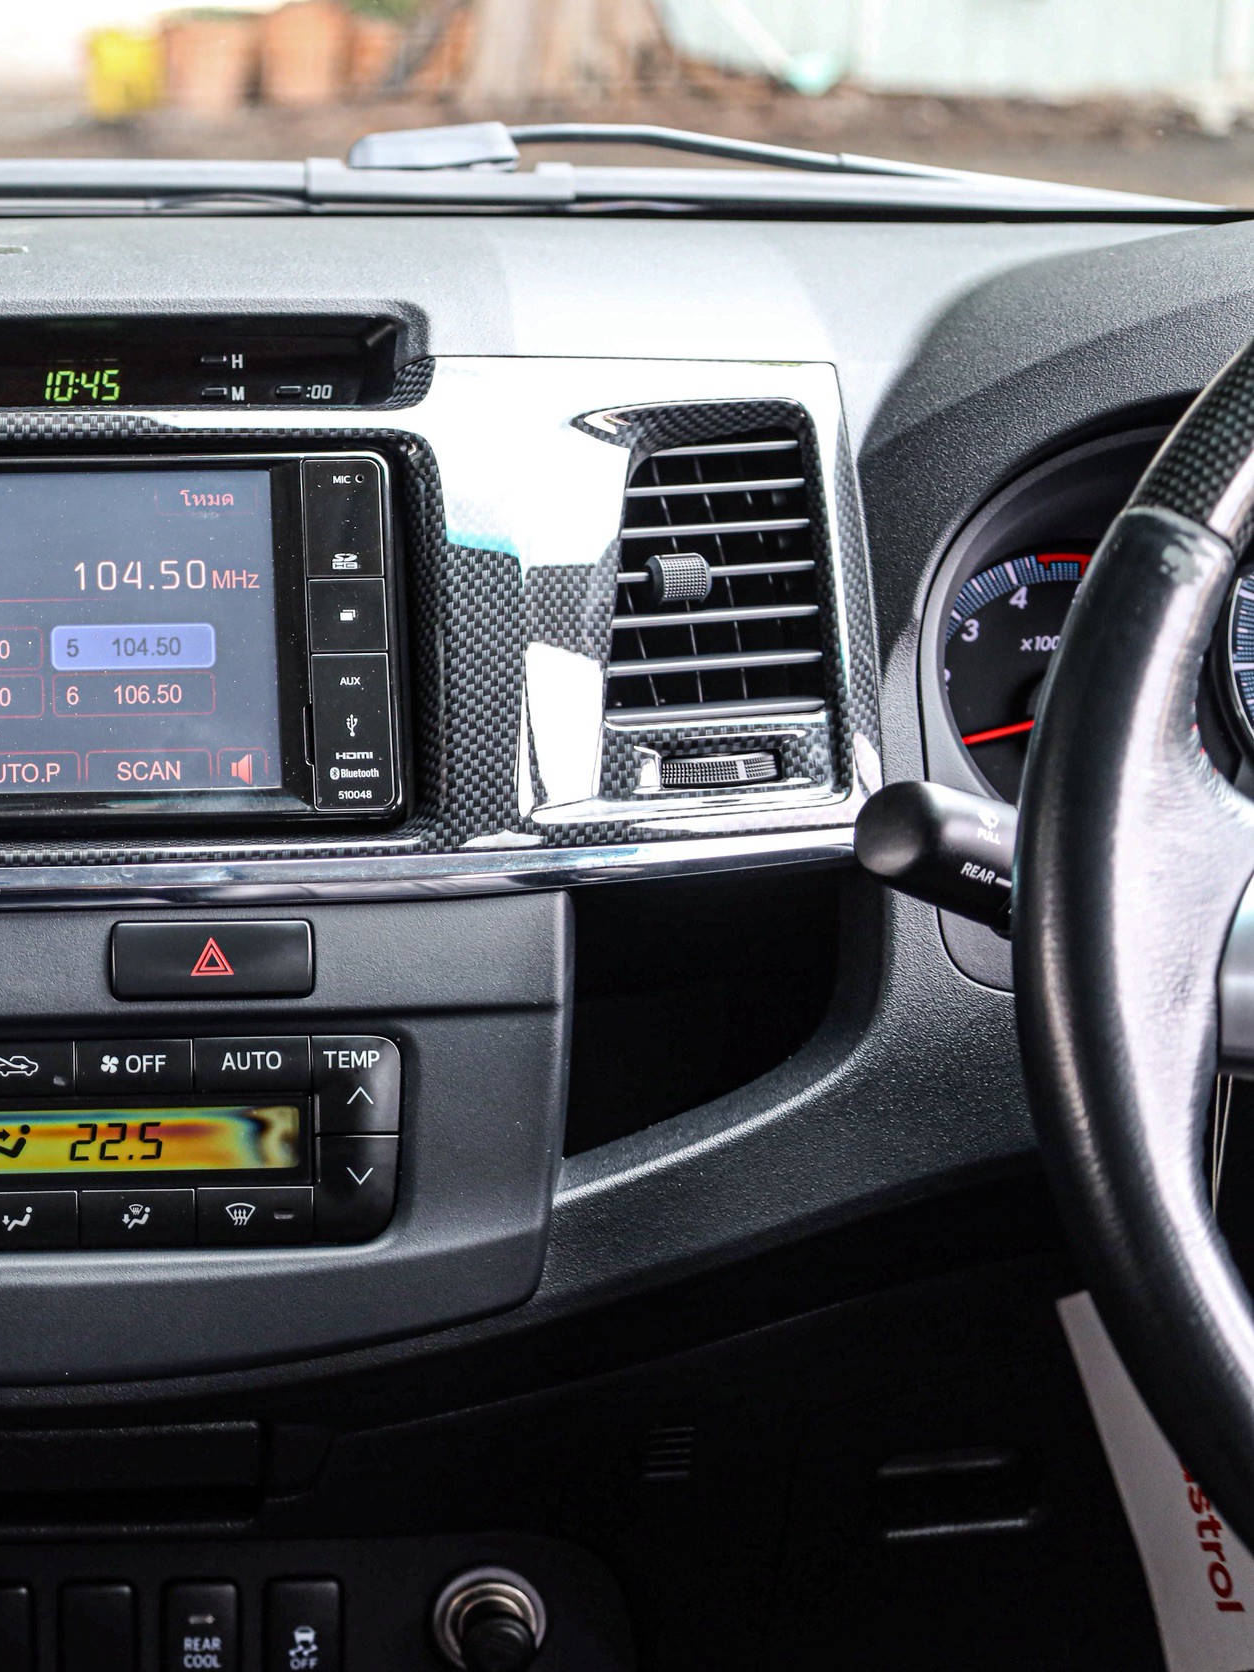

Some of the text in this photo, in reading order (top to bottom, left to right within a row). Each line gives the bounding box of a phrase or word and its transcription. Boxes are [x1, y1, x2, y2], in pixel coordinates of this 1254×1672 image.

[231, 354, 244, 369] H
[45, 369, 120, 402] 10:45
[231, 386, 245, 401] M
[305, 384, 333, 400] :00
[332, 475, 351, 484] MIC
[179, 489, 235, 507] โหมด
[74, 559, 261, 592] 104.50 MHz
[1008, 586, 1028, 609] 4
[961, 619, 980, 642] 3
[66, 636, 182, 658] 5 104.50
[339, 676, 361, 686] AUX
[66, 683, 183, 706] 6 106.50
[335, 751, 373, 760] HDMI
[116, 760, 182, 782] SCAN
[340, 767, 380, 778] Bluetooth
[337, 789, 373, 800] 510048
[960, 861, 996, 885] REAR
[125, 1054, 167, 1075] OFF
[221, 1050, 282, 1071] AUTO
[322, 1049, 381, 1069] TEMP
[69, 1122, 165, 1162] 22.5
[184, 1637, 222, 1652] REAR
[184, 1654, 221, 1668] COOL
[289, 1657, 318, 1670] OFF
